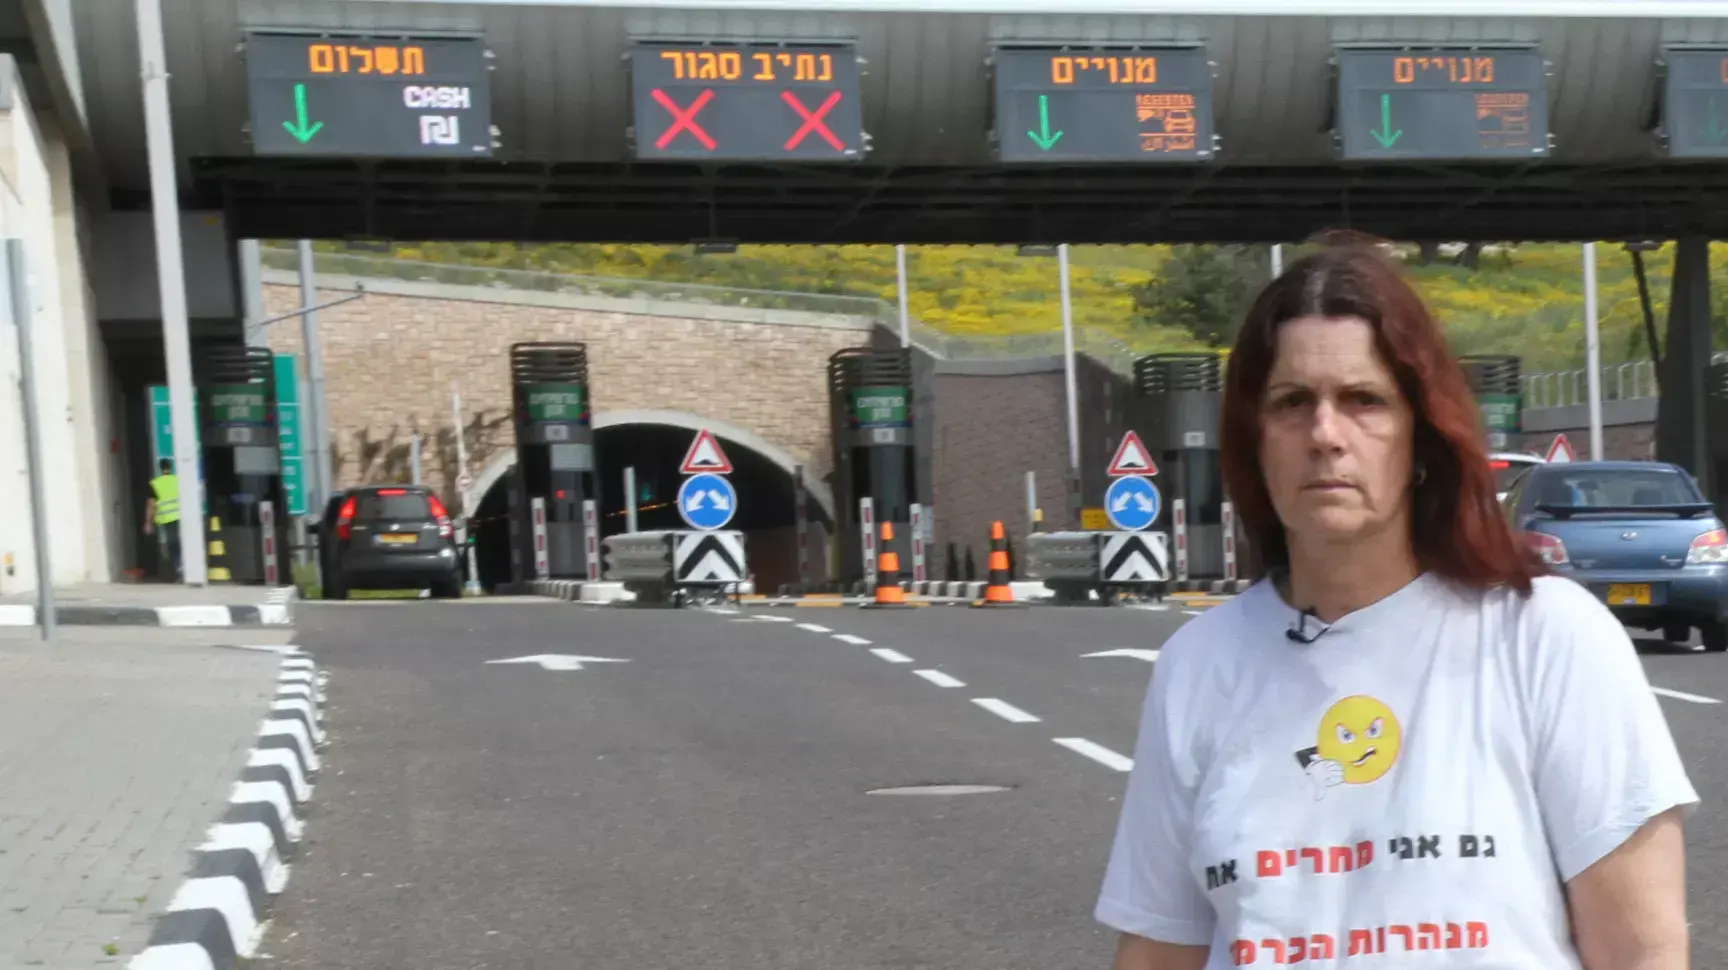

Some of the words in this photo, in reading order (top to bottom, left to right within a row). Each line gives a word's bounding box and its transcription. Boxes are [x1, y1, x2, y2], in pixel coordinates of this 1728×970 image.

[309, 45, 424, 74] תשלום
[660, 51, 742, 80] סגור
[752, 53, 834, 82] נתיב
[1052, 57, 1157, 84] מנויים
[1393, 57, 1494, 84] מנויים
[403, 86, 471, 109] CASH
[1256, 840, 1373, 877] מחרים
[1388, 834, 1442, 860] אני
[1459, 834, 1496, 858] גם
[1347, 921, 1488, 957] מנהרות
